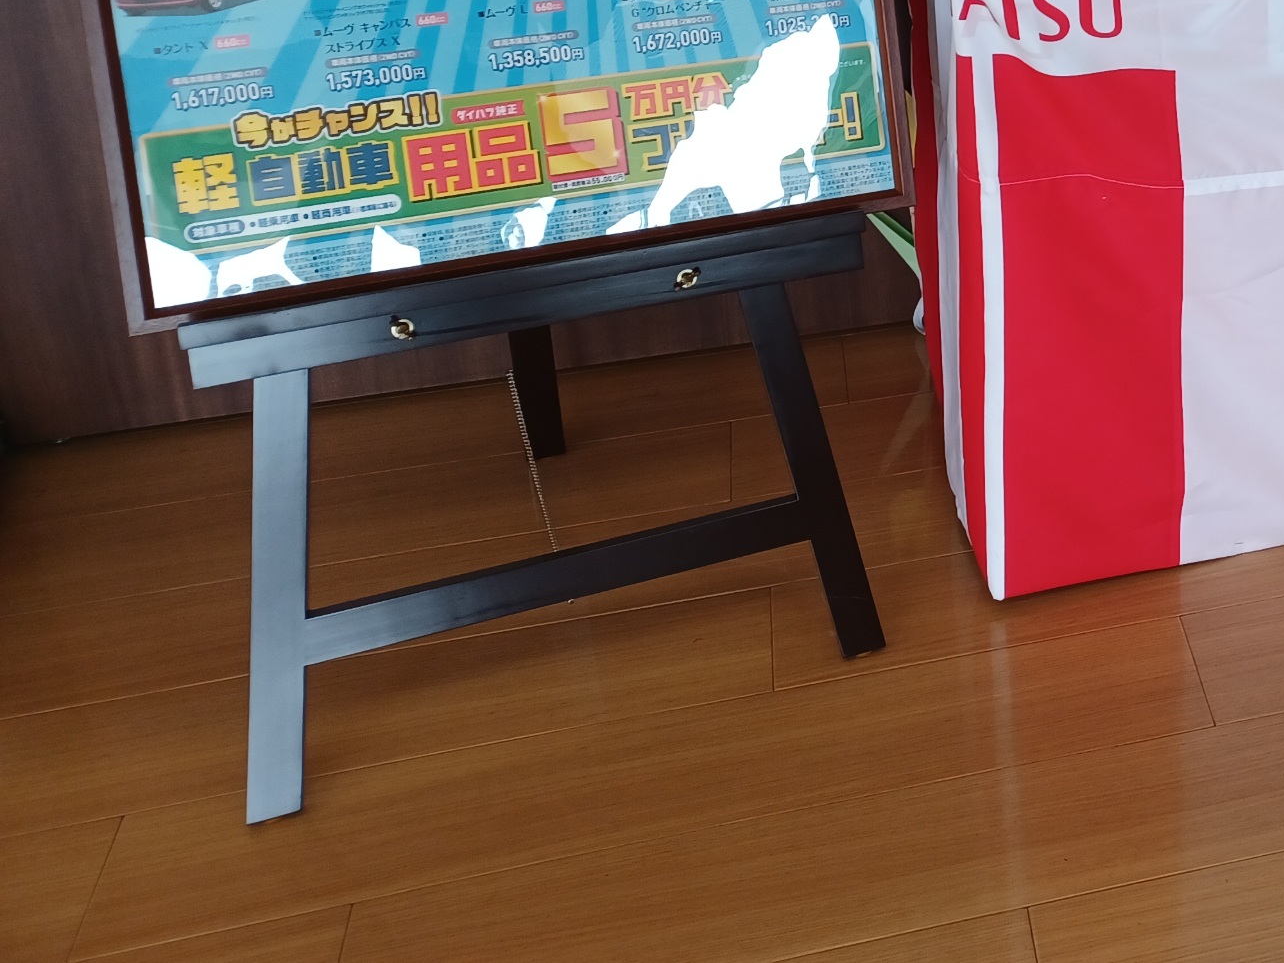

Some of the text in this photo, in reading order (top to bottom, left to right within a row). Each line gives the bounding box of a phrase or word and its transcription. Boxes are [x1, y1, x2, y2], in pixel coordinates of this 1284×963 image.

[765, 12, 851, 37] 1,025,0円
[162, 42, 194, 56] タント
[632, 27, 723, 55] 1,672,000円
[488, 43, 585, 73] 1,358,500円
[325, 63, 427, 92] 1,573,000円
[171, 81, 275, 111] 1,617,000円
[402, 122, 541, 202] 用品
